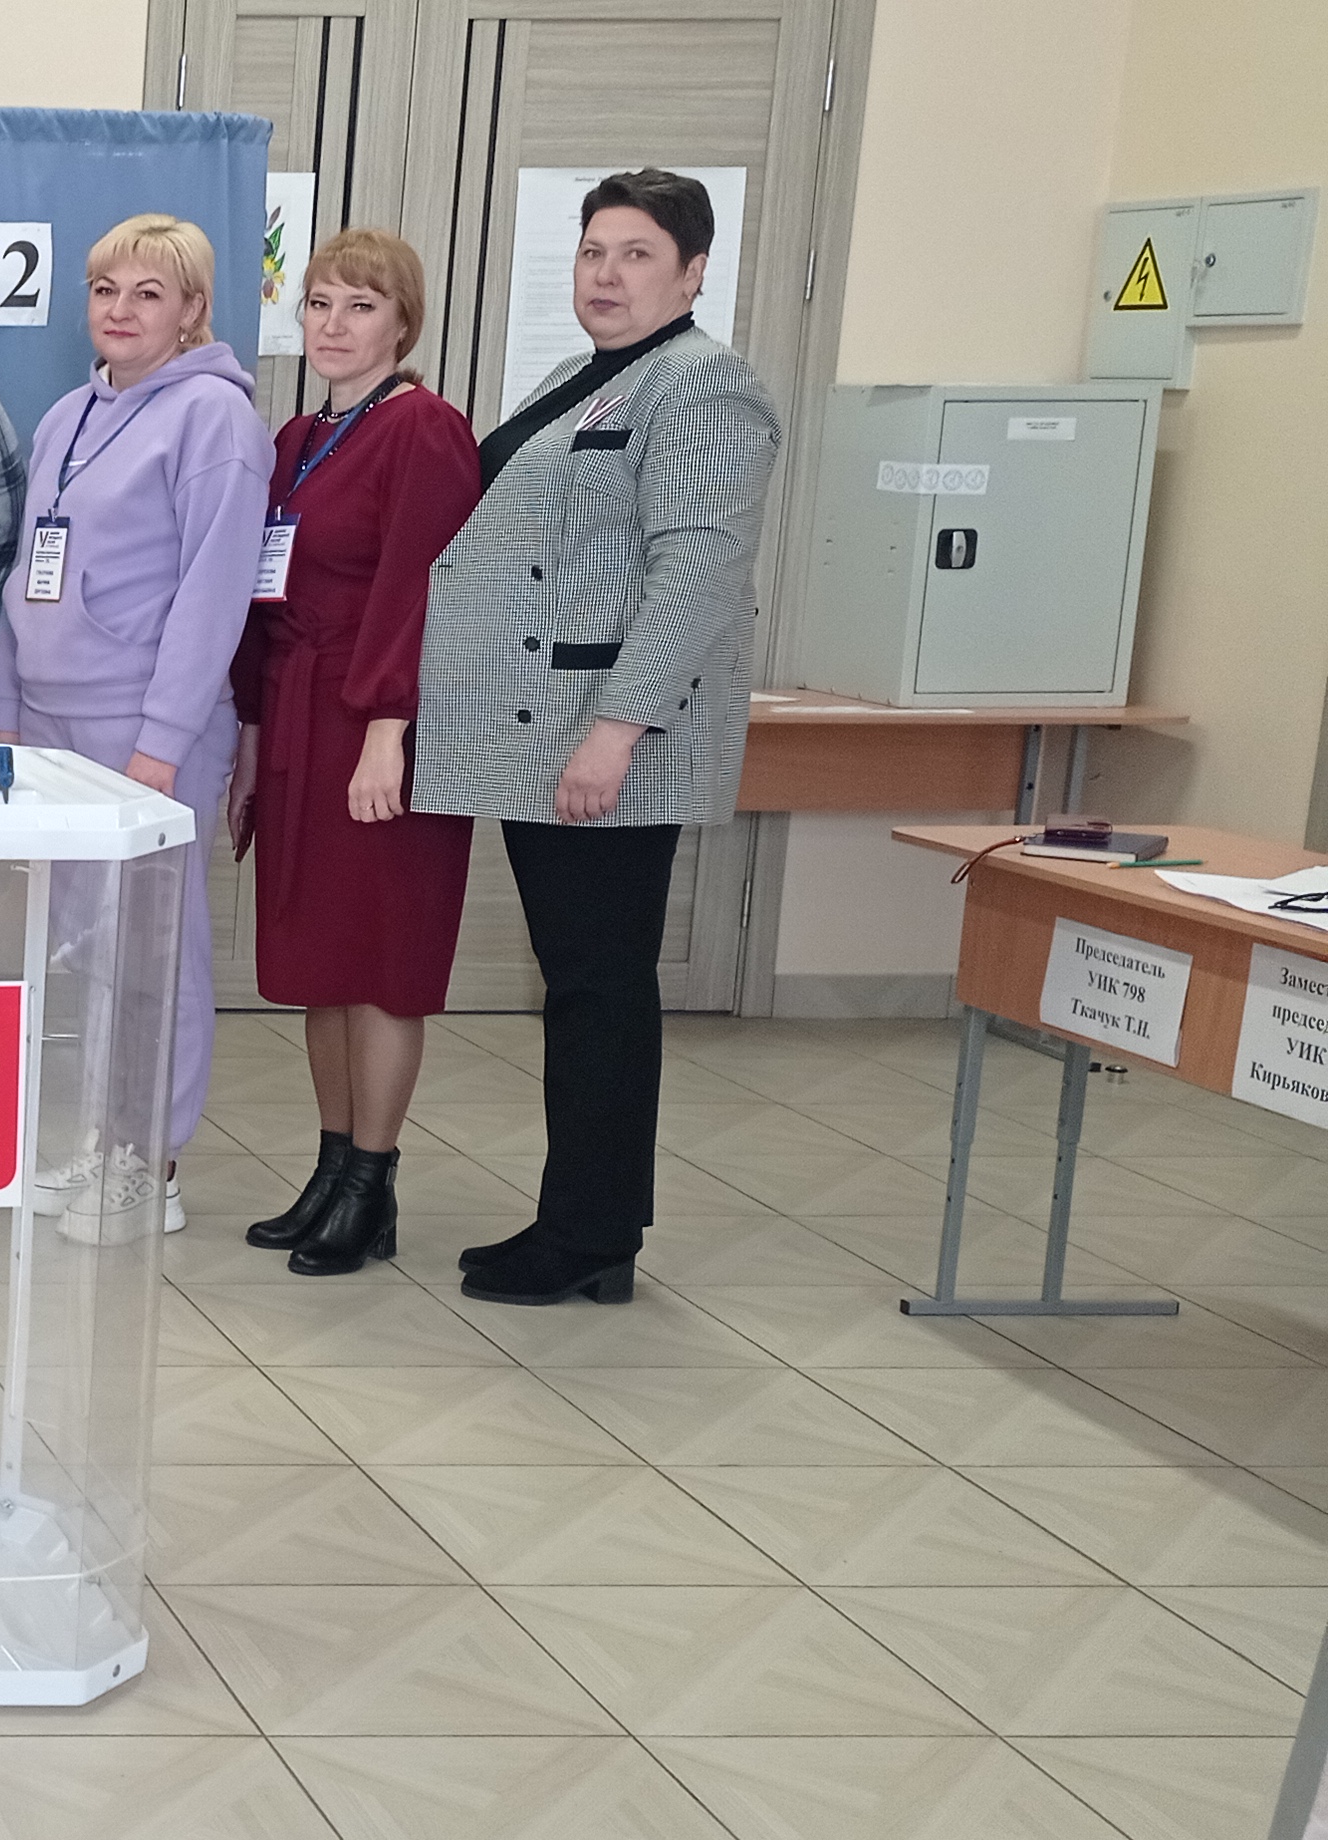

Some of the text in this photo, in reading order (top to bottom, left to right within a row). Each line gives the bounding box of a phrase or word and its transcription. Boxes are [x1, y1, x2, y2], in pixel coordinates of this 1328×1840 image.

[0, 240, 41, 307] 2
[1074, 936, 1166, 979] Председатель
[1087, 970, 1147, 1003] УИК 798
[1070, 997, 1122, 1029] Ткачук
[1286, 1037, 1328, 1066] УИК
[1250, 1060, 1328, 1103] Кирьяков
